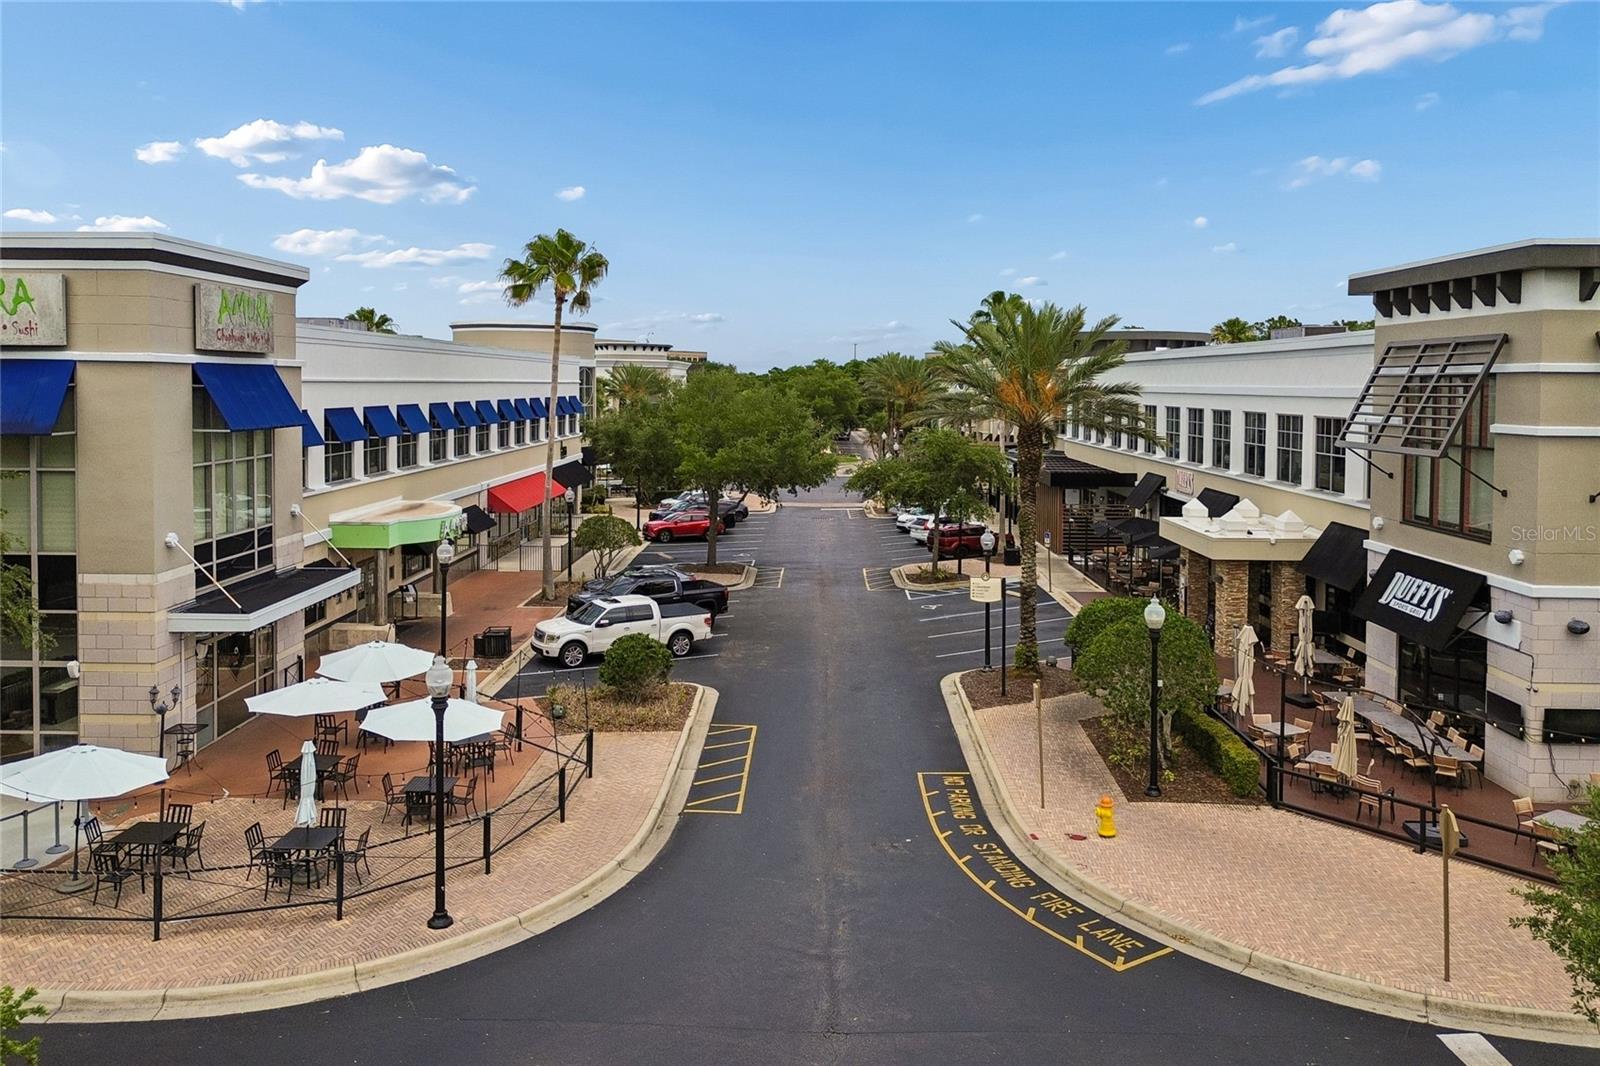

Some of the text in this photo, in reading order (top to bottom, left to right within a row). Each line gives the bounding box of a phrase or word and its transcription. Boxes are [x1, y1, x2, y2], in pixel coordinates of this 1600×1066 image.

[12, 320, 38, 336] Sushi
[217, 288, 270, 329] AMURA
[943, 776, 1144, 953] NO PARKING OR STANDING FIRE LANE
